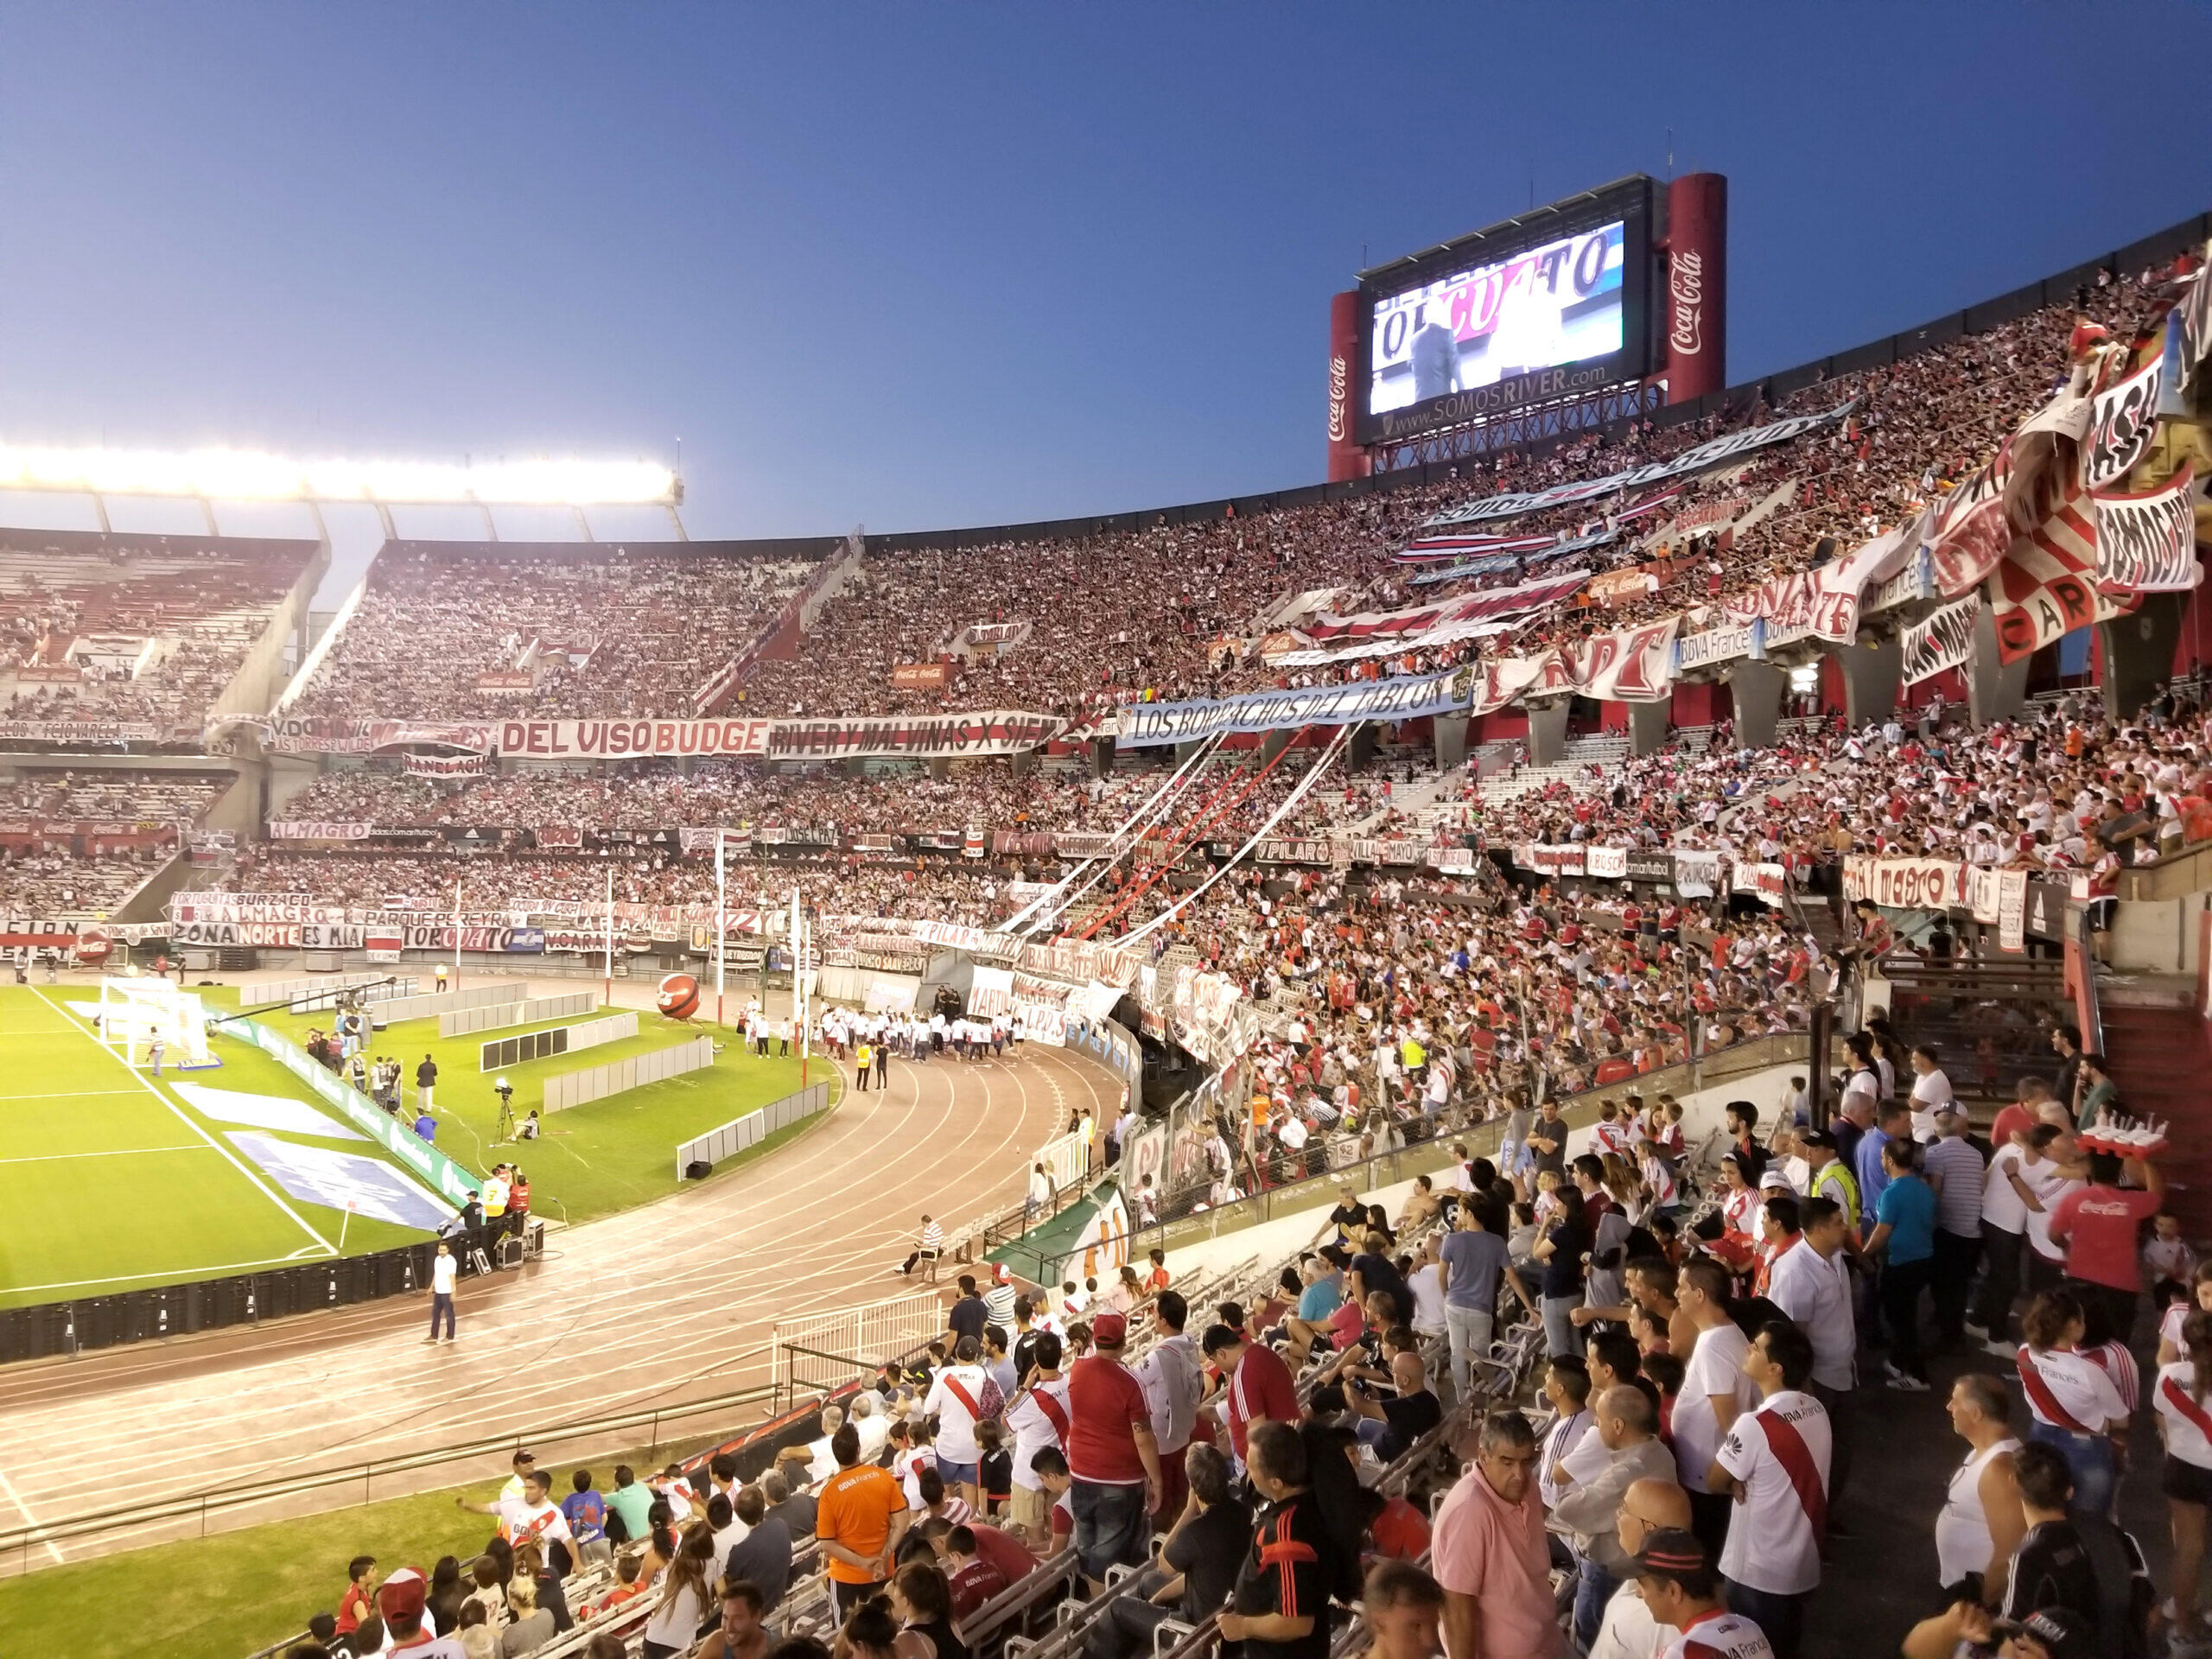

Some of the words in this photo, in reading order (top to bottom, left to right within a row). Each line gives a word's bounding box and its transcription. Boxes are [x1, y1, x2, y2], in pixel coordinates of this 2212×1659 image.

[1671, 249, 1701, 355] Coca-Cola
[1328, 354, 1346, 442] Coca-Cola
[1681, 639, 1708, 663] BBVA
[1134, 709, 1178, 741] LOS
[1177, 694, 1308, 737] BORRACHOS
[1299, 690, 1348, 721] DEL
[502, 721, 569, 753] DEL
[577, 721, 652, 753] VISO
[655, 721, 769, 753] BUDGE
[772, 720, 841, 753] RIVER
[844, 722, 860, 752] Y
[857, 718, 971, 753] MALVINAS
[976, 716, 998, 750] X
[272, 823, 365, 837] ALMAGRO
[1268, 843, 1316, 860] PILAR
[1389, 843, 1413, 861] MAYO
[221, 907, 326, 923] ALMAGRO
[365, 912, 434, 926] PARQUE
[173, 924, 236, 943] ZONA
[238, 924, 300, 946] NORTE
[302, 926, 320, 945] ES
[330, 926, 359, 946] MIA
[929, 923, 969, 944] PILAR
[837, 1478, 857, 1492] BBVA
